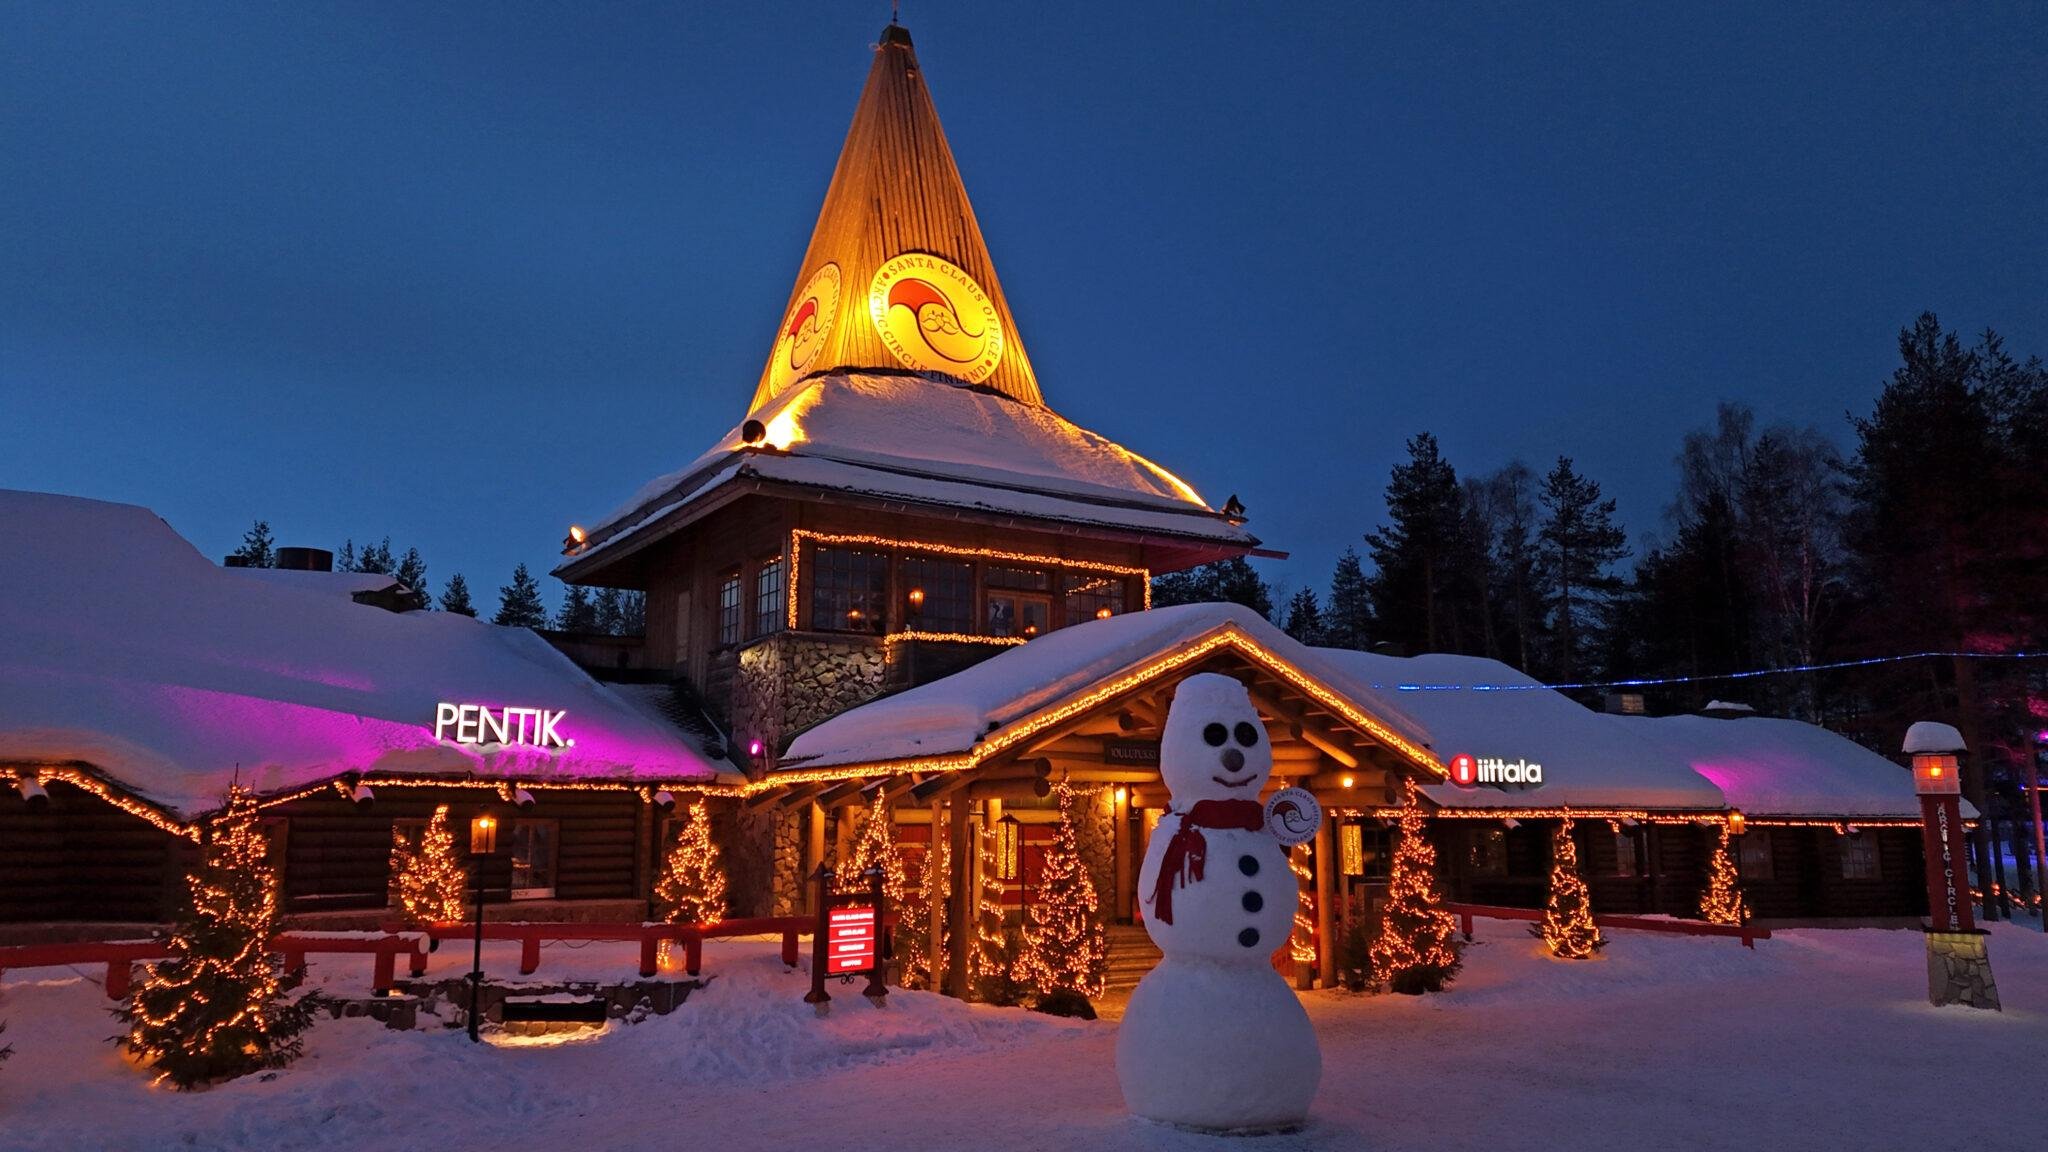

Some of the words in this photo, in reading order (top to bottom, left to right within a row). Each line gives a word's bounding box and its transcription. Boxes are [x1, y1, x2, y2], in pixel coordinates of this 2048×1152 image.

[873, 277, 888, 328] ARCTIC
[883, 331, 928, 373] CIRCLE
[930, 365, 987, 385] FINLAND
[888, 257, 935, 276] SANTA
[940, 264, 984, 302] CLAUS
[983, 306, 1000, 360] OFFICE
[1477, 758, 1542, 783] iittala
[1945, 868, 1959, 925] CIRCLE
